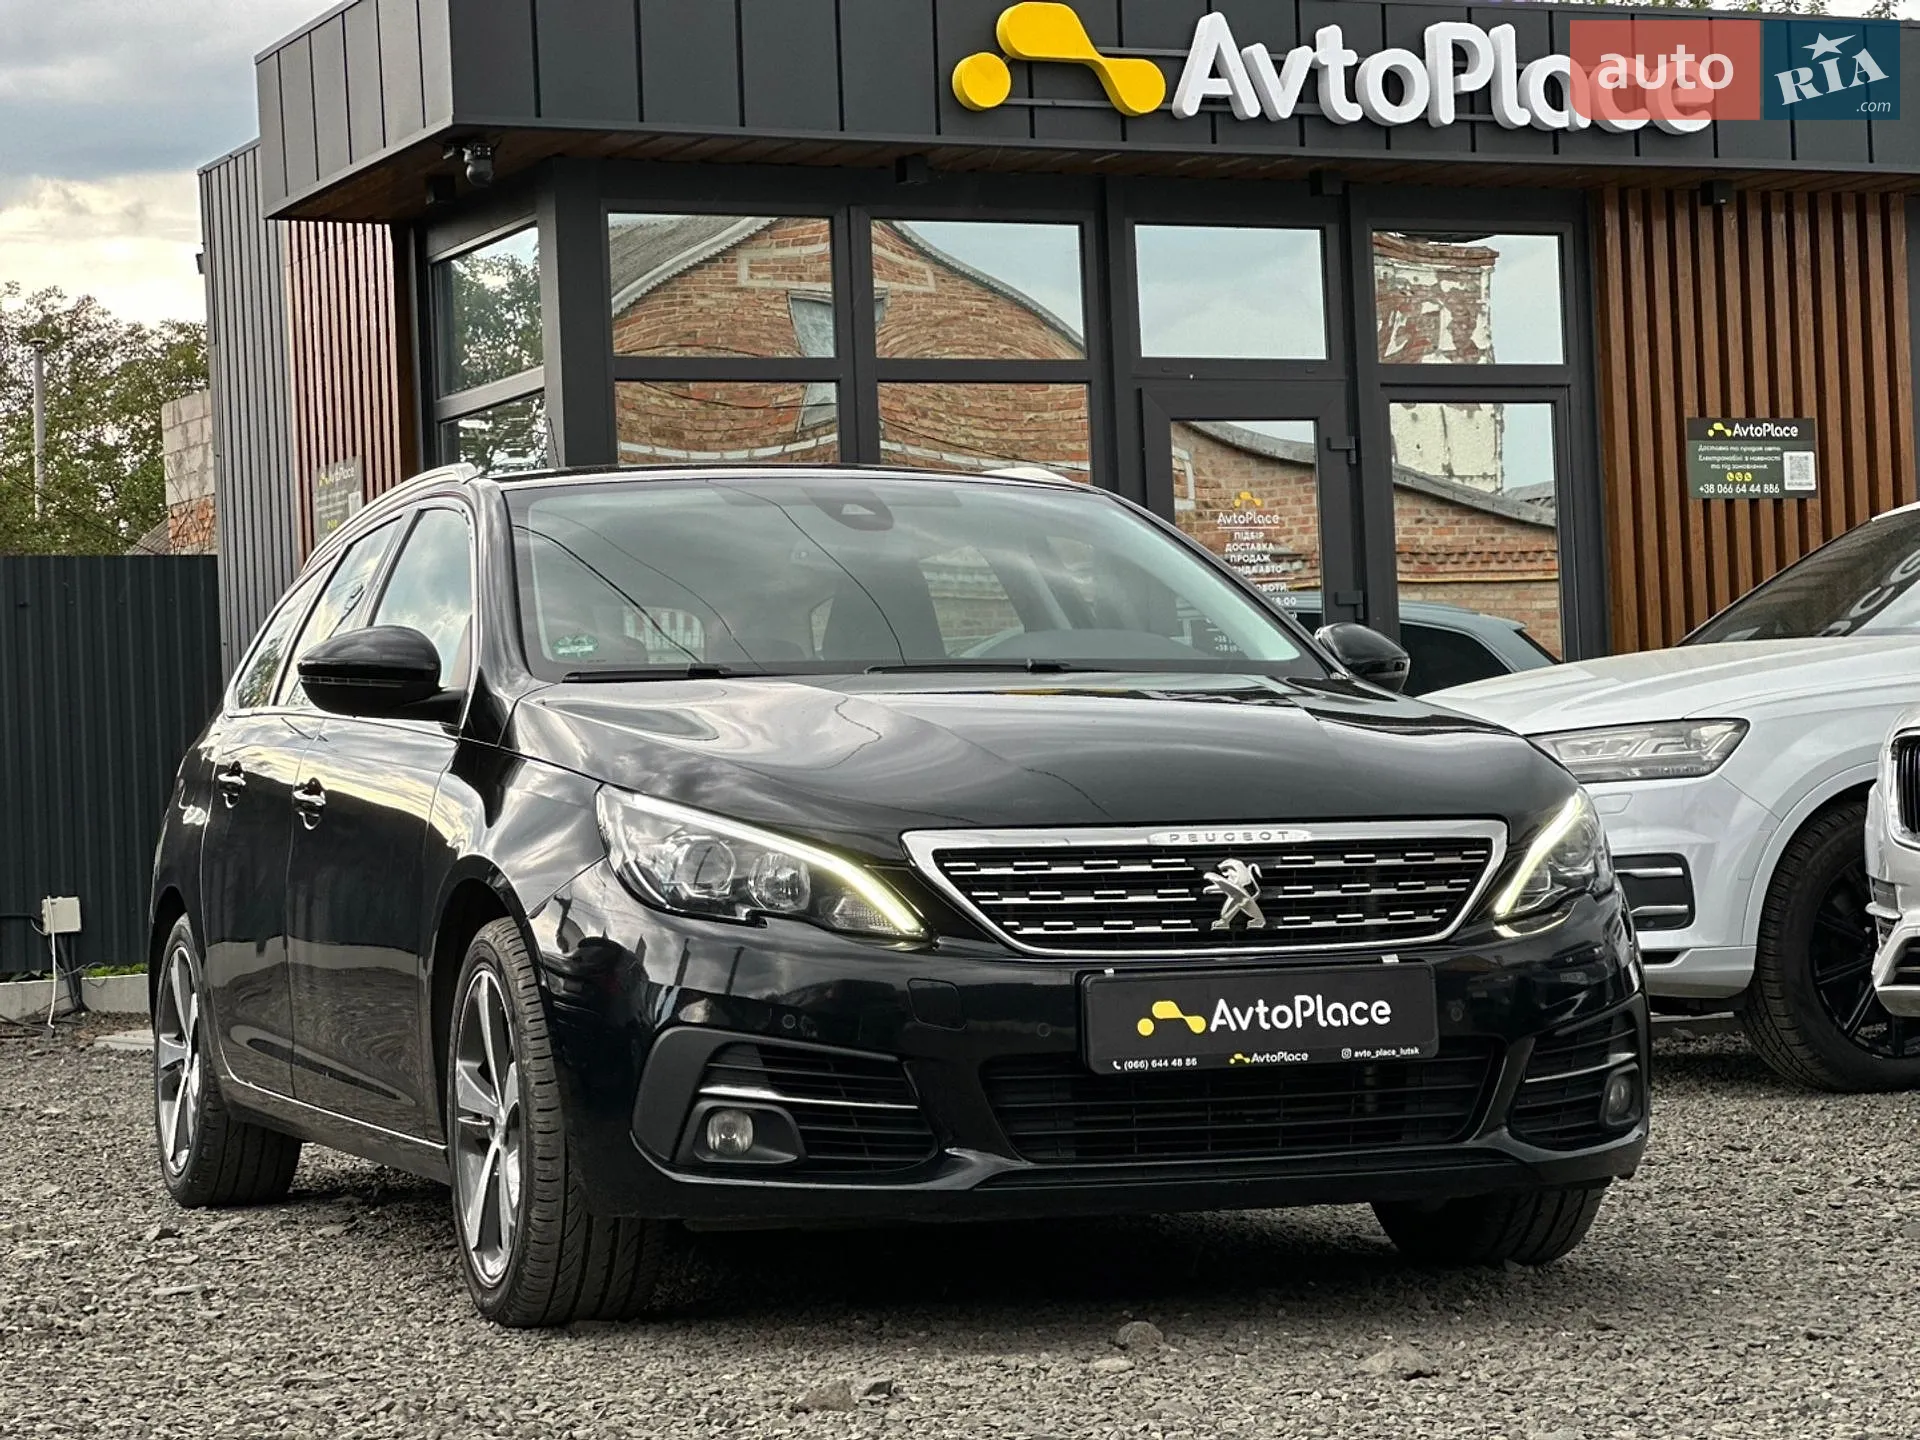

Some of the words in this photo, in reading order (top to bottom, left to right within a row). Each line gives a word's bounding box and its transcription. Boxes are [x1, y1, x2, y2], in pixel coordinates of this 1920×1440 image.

[1172, 11, 1714, 136] AvtoPlace
[1733, 422, 1799, 438] AvtoPlace
[1699, 484, 1715, 494] +38
[1717, 484, 1733, 494] 066
[1735, 484, 1747, 494] 64
[1749, 484, 1761, 494] 44
[1763, 484, 1780, 494] 886
[1217, 511, 1280, 525] AvtoPlace
[1234, 531, 1265, 541] ПІДБІР
[1225, 542, 1275, 553] ДОСТАВКА
[1230, 553, 1271, 564] ПРОДАЖ
[1169, 831, 1289, 844] PEUGEOT
[1210, 994, 1392, 1033] AvtoPlace
[1251, 1051, 1309, 1064] AvtoPlace
[1354, 1046, 1420, 1059] avto_place_lutsk
[1123, 1059, 1149, 1071] (066)
[1151, 1058, 1169, 1068] 644
